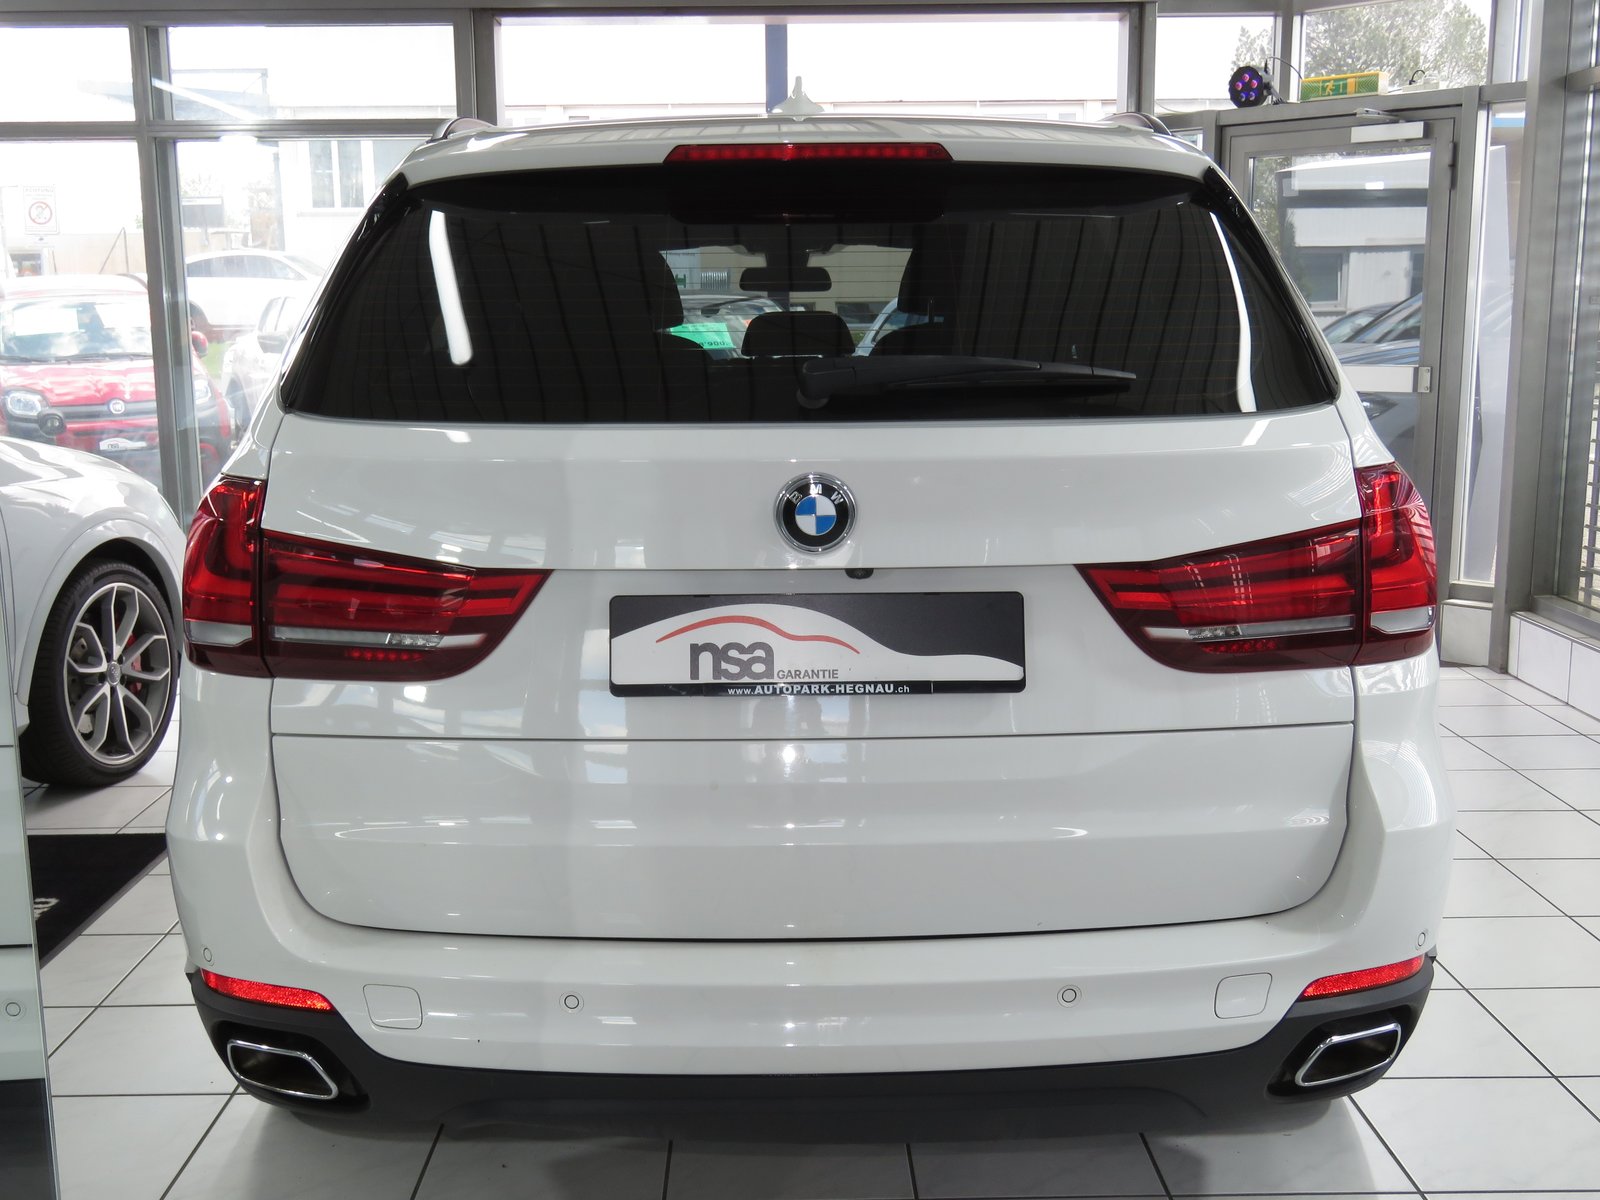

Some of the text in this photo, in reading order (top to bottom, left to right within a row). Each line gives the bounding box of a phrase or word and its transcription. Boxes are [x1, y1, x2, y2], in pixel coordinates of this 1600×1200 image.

[789, 483, 844, 505] BMW
[690, 642, 775, 681] nsa
[777, 669, 839, 680] GARANTIE
[727, 683, 910, 695] www.AUTOPARK-HEGNAU.ch
